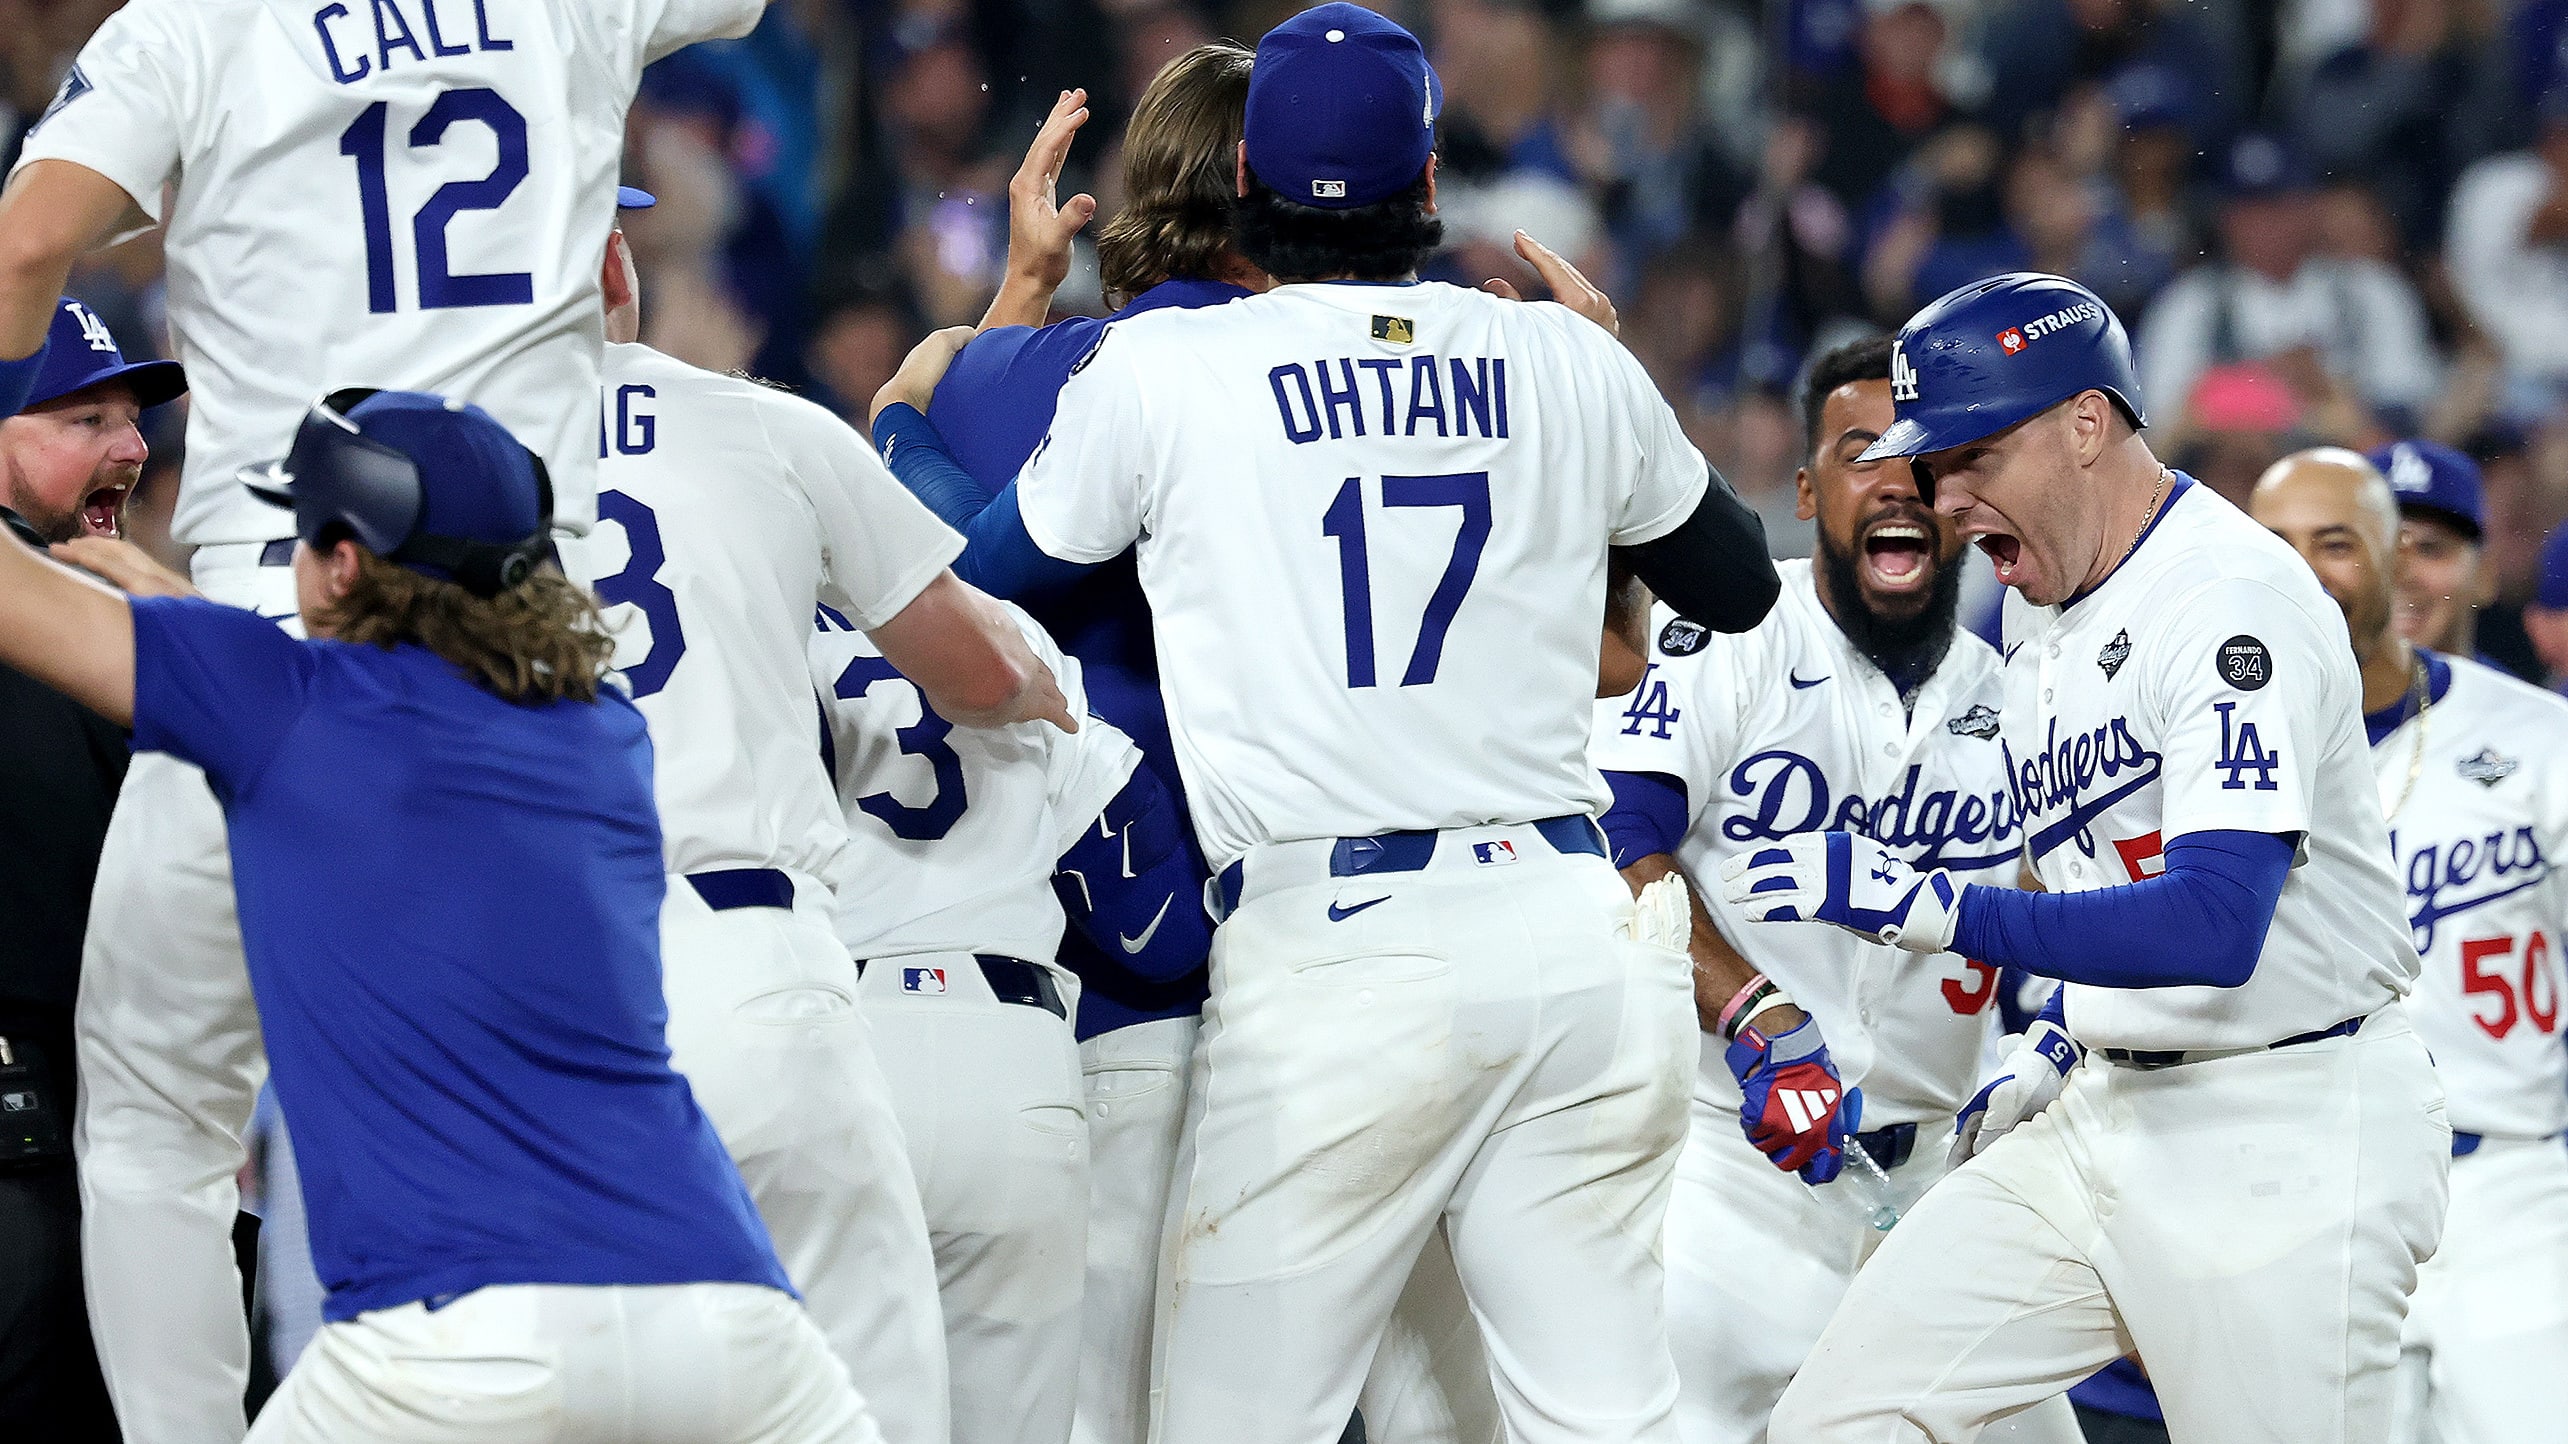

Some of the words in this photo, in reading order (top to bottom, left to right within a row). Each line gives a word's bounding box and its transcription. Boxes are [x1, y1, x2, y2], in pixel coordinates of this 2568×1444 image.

[314, 0, 513, 84] CALL
[340, 88, 533, 313] 12
[64, 302, 117, 353] LA
[2023, 301, 2099, 341] STRAUSS
[1269, 355, 1510, 445] OHTANI
[1891, 340, 1919, 401] LA
[1322, 471, 1493, 689] 17
[2225, 646, 2262, 655] FERNANDO
[2228, 655, 2263, 681] 34
[1620, 663, 1680, 740] LA
[2001, 715, 2163, 859] odgers
[2213, 701, 2279, 791] LA
[1722, 749, 2023, 873] Dodger
[2461, 930, 2558, 1040] 50
[2049, 1041, 2069, 1063] 5
